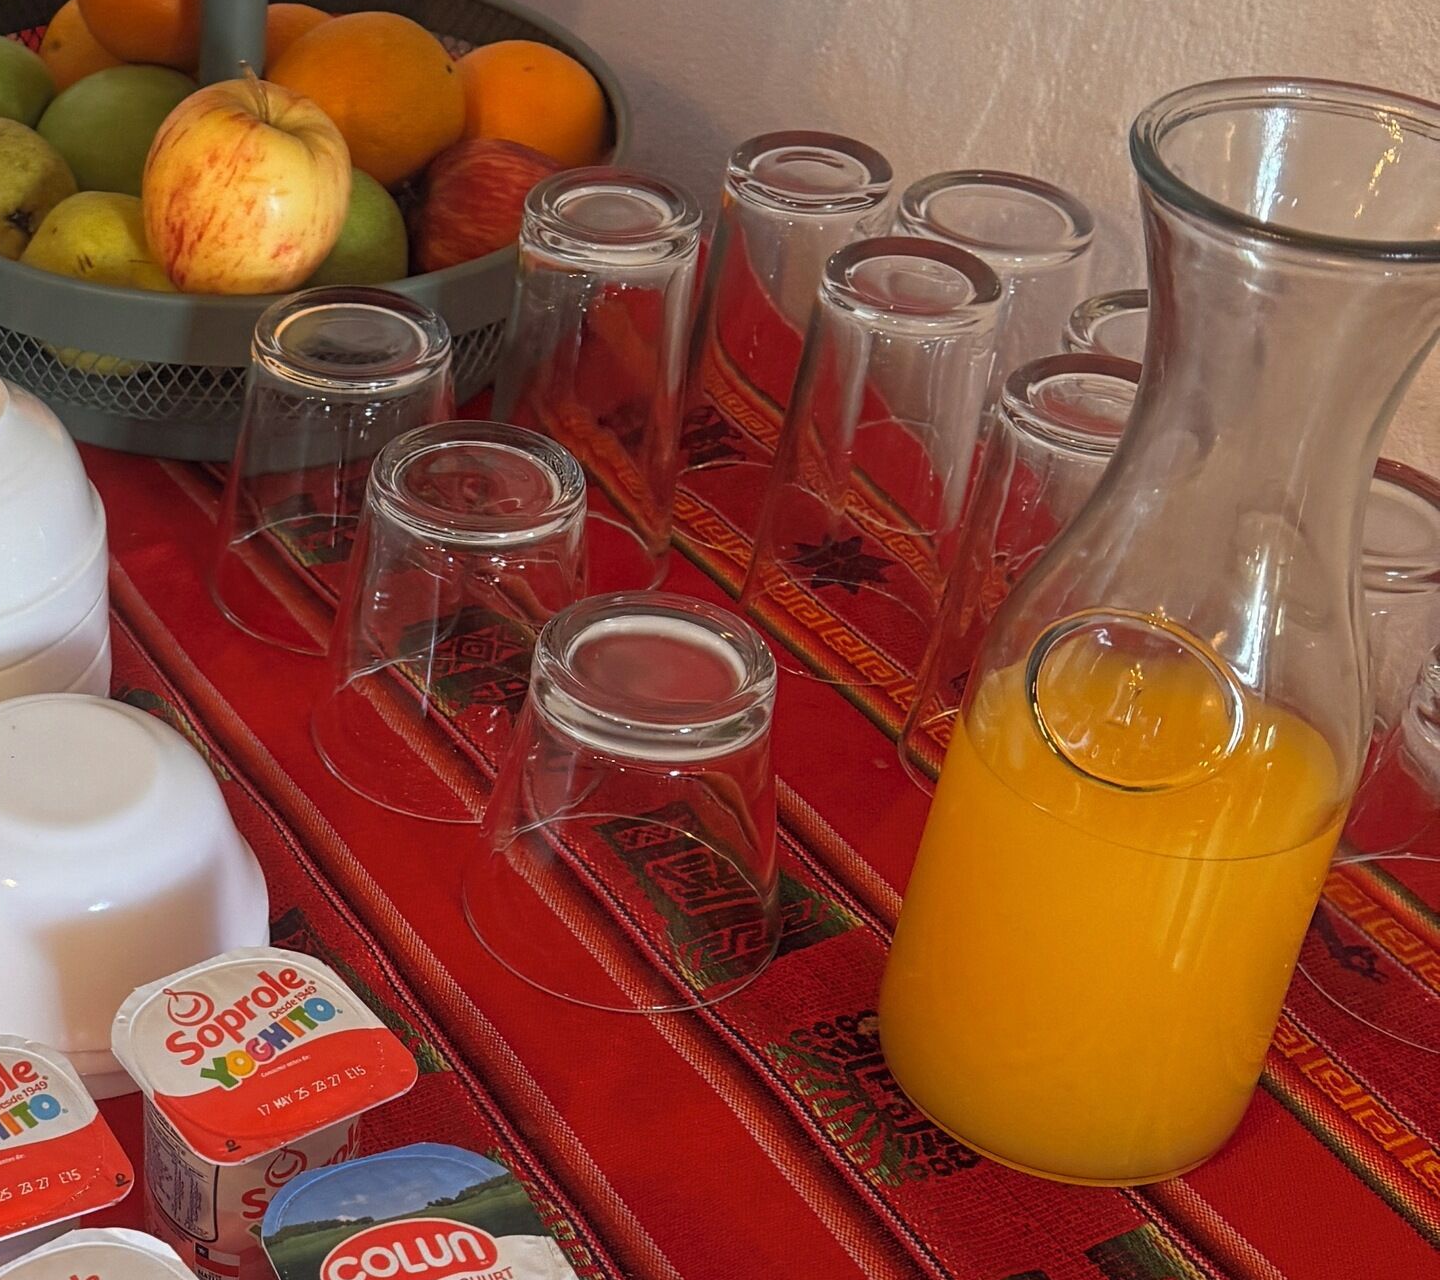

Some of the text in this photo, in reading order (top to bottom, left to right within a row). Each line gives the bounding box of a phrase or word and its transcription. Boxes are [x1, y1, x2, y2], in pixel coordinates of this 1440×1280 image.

[165, 968, 307, 1065] Soprole
[268, 999, 297, 1019] Desde
[200, 997, 336, 1089] YOGHITO
[22, 1080, 48, 1097] 1949
[257, 1103, 271, 1116] 17
[272, 1094, 294, 1109] MAY
[294, 1086, 310, 1100] 25
[344, 1065, 367, 1079] E15
[58, 1168, 81, 1184] E15
